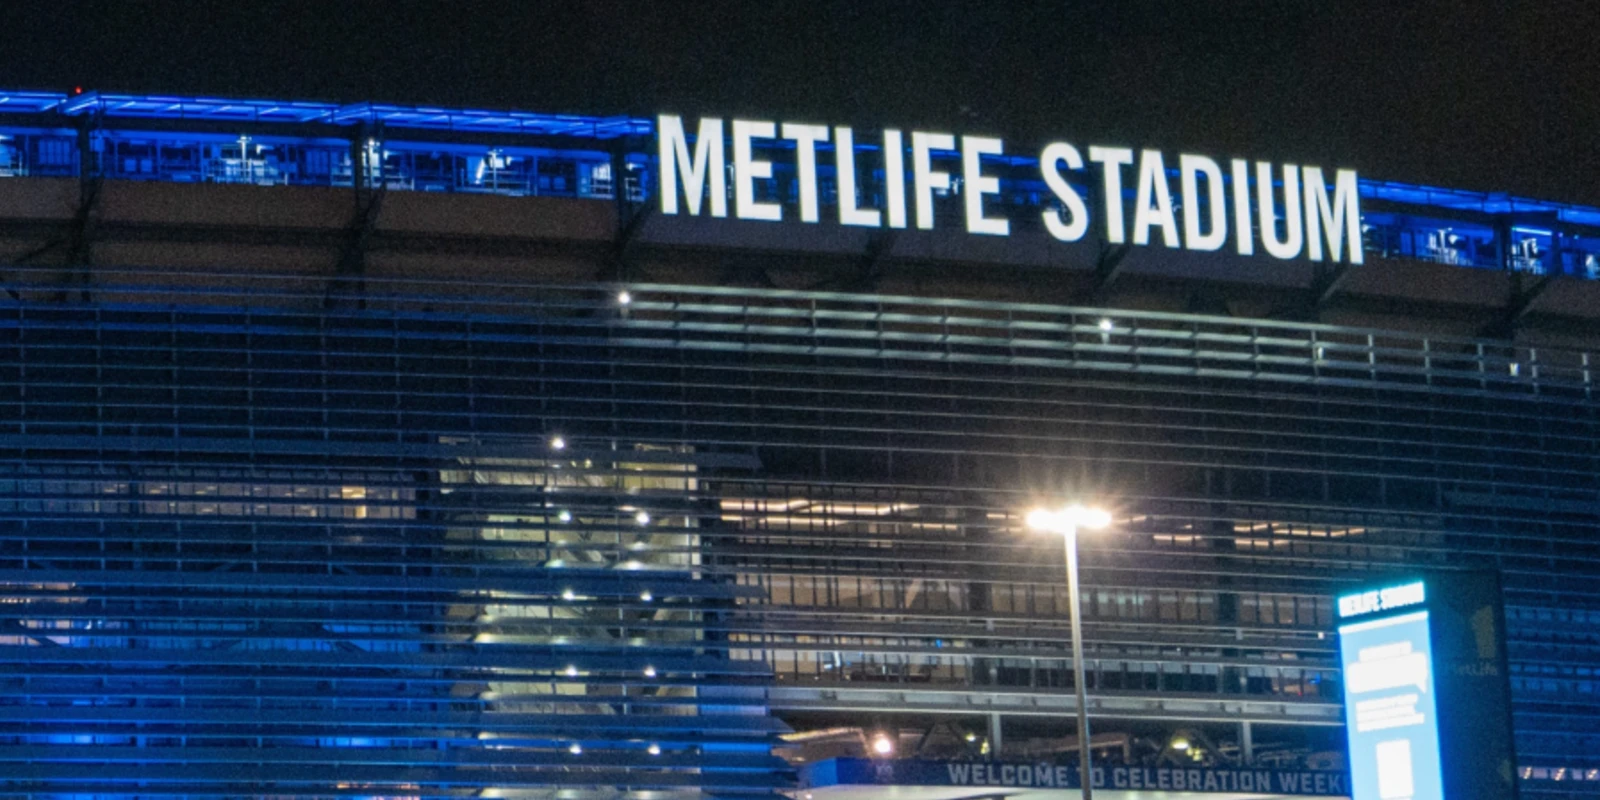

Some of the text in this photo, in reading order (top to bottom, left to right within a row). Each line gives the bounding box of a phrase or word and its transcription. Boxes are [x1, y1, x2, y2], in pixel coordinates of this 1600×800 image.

[657, 114, 1364, 265] METLIFE STADIUM
[948, 763, 1069, 787] WELCOME
[1075, 765, 1105, 788] O
[1113, 766, 1272, 792] CELEBRATION
